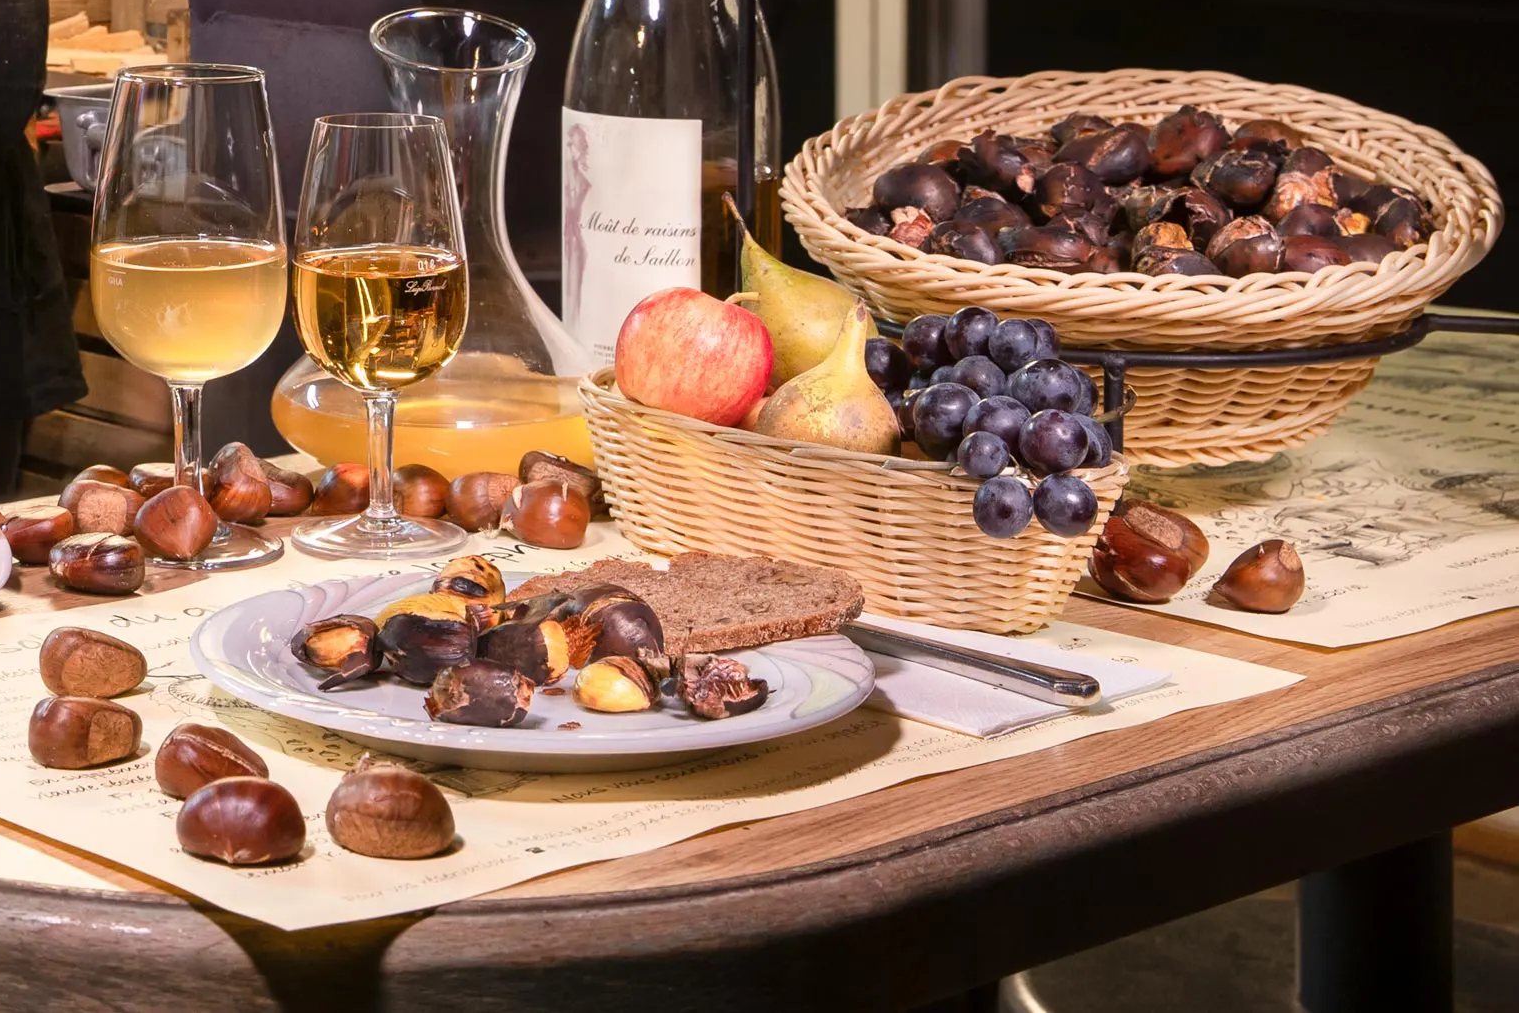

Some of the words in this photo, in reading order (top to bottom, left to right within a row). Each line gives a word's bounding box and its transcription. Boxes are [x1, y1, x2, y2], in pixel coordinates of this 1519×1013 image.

[580, 210, 620, 234] Moût
[622, 217, 640, 235] de
[644, 222, 697, 238] raisins
[614, 245, 631, 264] de
[633, 244, 696, 267] Saillon
